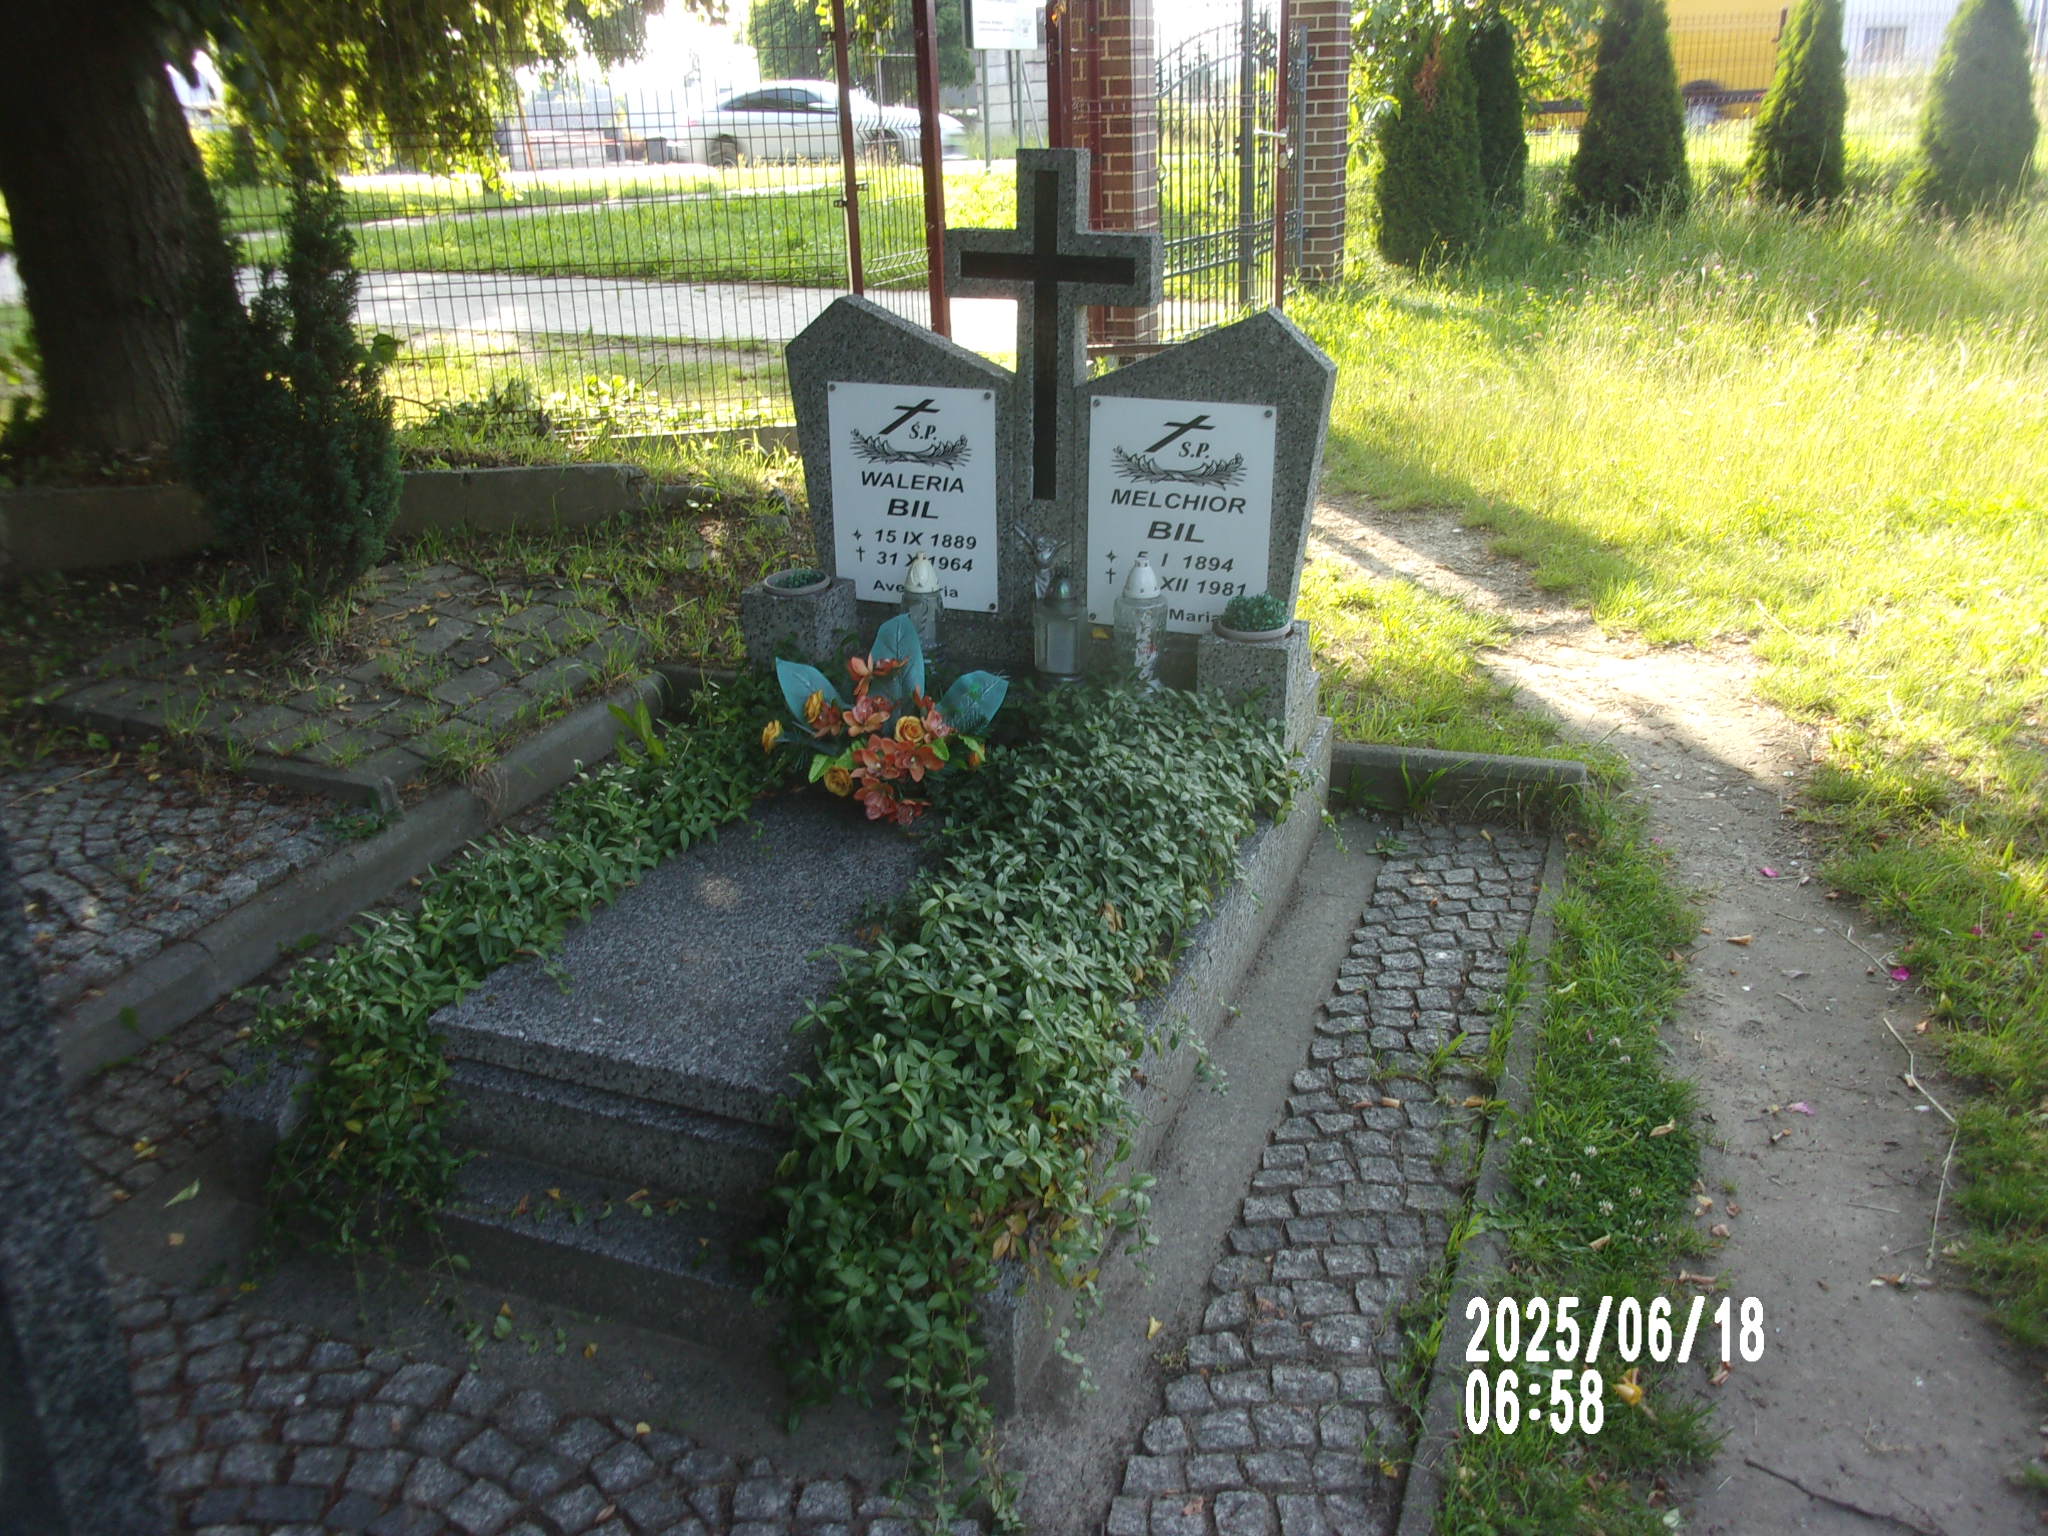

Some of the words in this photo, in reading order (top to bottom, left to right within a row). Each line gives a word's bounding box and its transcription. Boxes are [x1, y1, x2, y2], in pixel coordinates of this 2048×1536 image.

[862, 471, 964, 493] WALERIA
[887, 499, 939, 519] BIL
[1111, 489, 1246, 514] MELCHIOR
[875, 529, 896, 543] 15
[903, 531, 923, 545] IX
[931, 534, 976, 549] 1889
[1147, 521, 1205, 543] BIL
[877, 552, 897, 565] 31
[928, 556, 973, 572] 1964
[1162, 553, 1168, 566] I
[1184, 555, 1234, 572] 1894
[873, 580, 904, 593] Ave
[1160, 576, 1188, 592] XII
[1197, 580, 1246, 596] 1981
